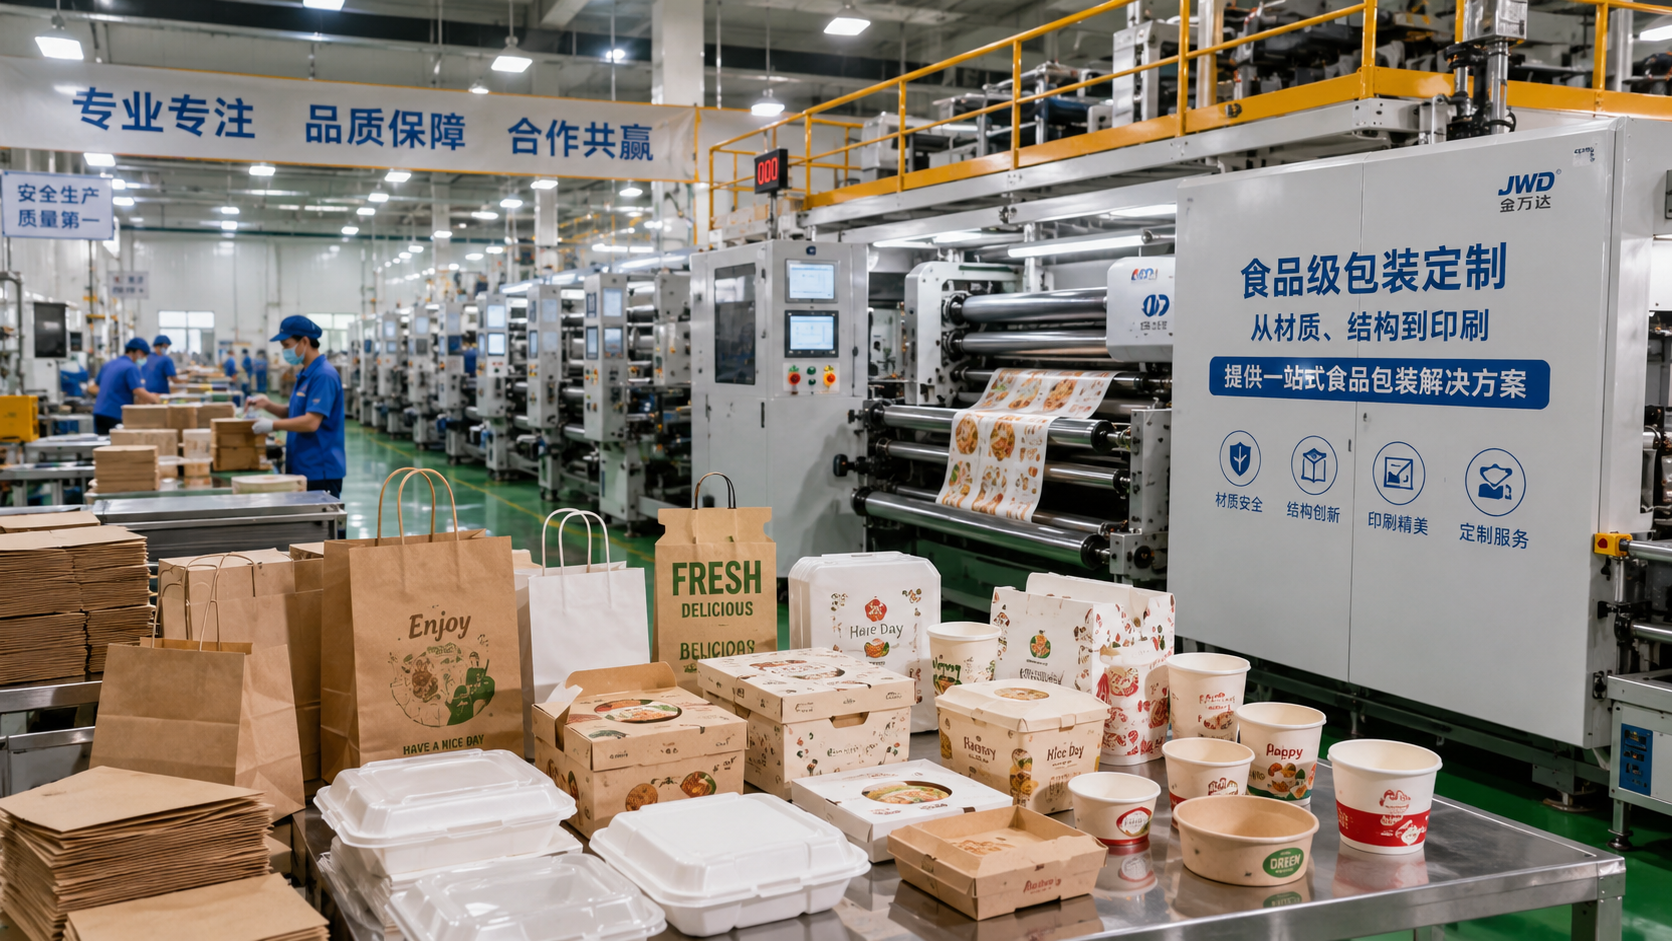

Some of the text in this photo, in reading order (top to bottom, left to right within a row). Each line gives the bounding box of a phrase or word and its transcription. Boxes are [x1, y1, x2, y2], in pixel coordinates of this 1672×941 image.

[72, 87, 653, 161] 专业专注 品质保障 合作共赢
[17, 183, 99, 205] 安全生产
[1498, 171, 1555, 196] JWD
[1500, 195, 1551, 212] 金万达
[17, 209, 100, 229] 质量第一
[1240, 241, 1507, 299] 食品级包装定制
[1250, 308, 1489, 343] 从材质、结构到印刷
[1224, 363, 1527, 399] 提供一站式食品包装解决方案
[1215, 492, 1263, 513] 材质安全
[1286, 501, 1340, 524] 结构创新
[1367, 511, 1428, 536] 印刷精美
[1459, 523, 1529, 550] 定制服务
[672, 560, 761, 596] FRESH
[682, 601, 754, 618] DELICIOUS
[408, 610, 471, 642] Enjoy
[880, 623, 904, 639] Day
[403, 734, 484, 755] HAVE A NICE DAY
